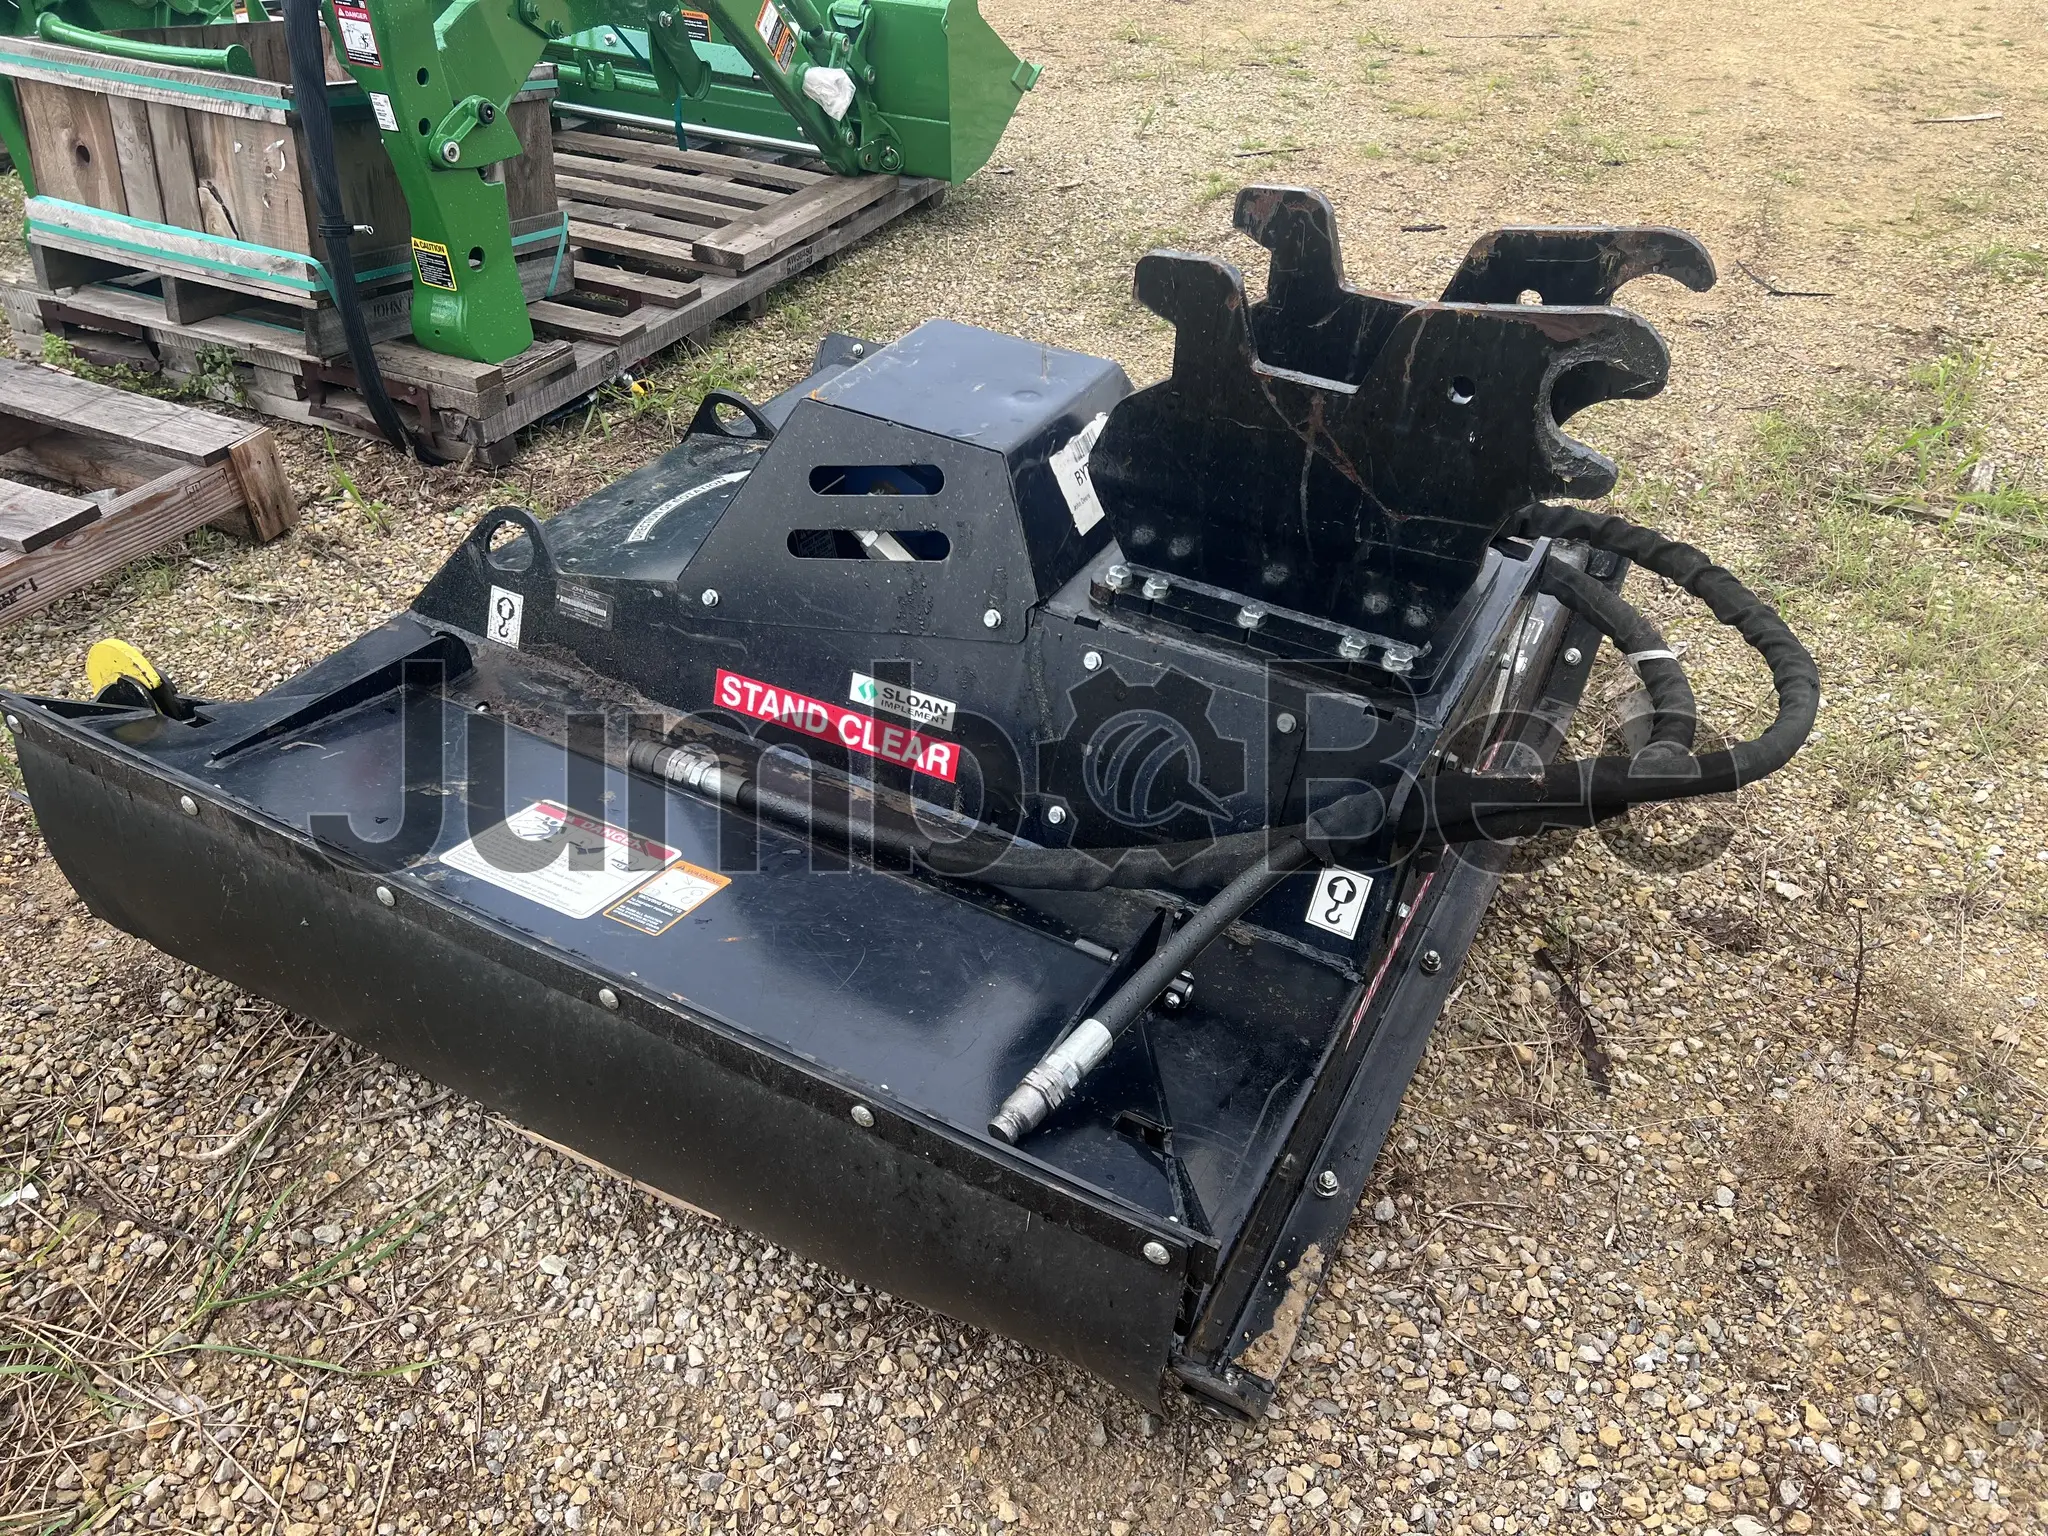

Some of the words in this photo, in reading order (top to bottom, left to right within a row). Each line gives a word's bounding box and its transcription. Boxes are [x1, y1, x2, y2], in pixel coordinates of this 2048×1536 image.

[345, 11, 368, 20] DANGER
[419, 241, 445, 253] CAUTION
[880, 700, 948, 726] IMPLEMENT
[882, 687, 949, 717] SLOAN
[721, 676, 829, 734] STAND
[837, 714, 951, 777] CLEAR
[580, 820, 646, 851] DANGER
